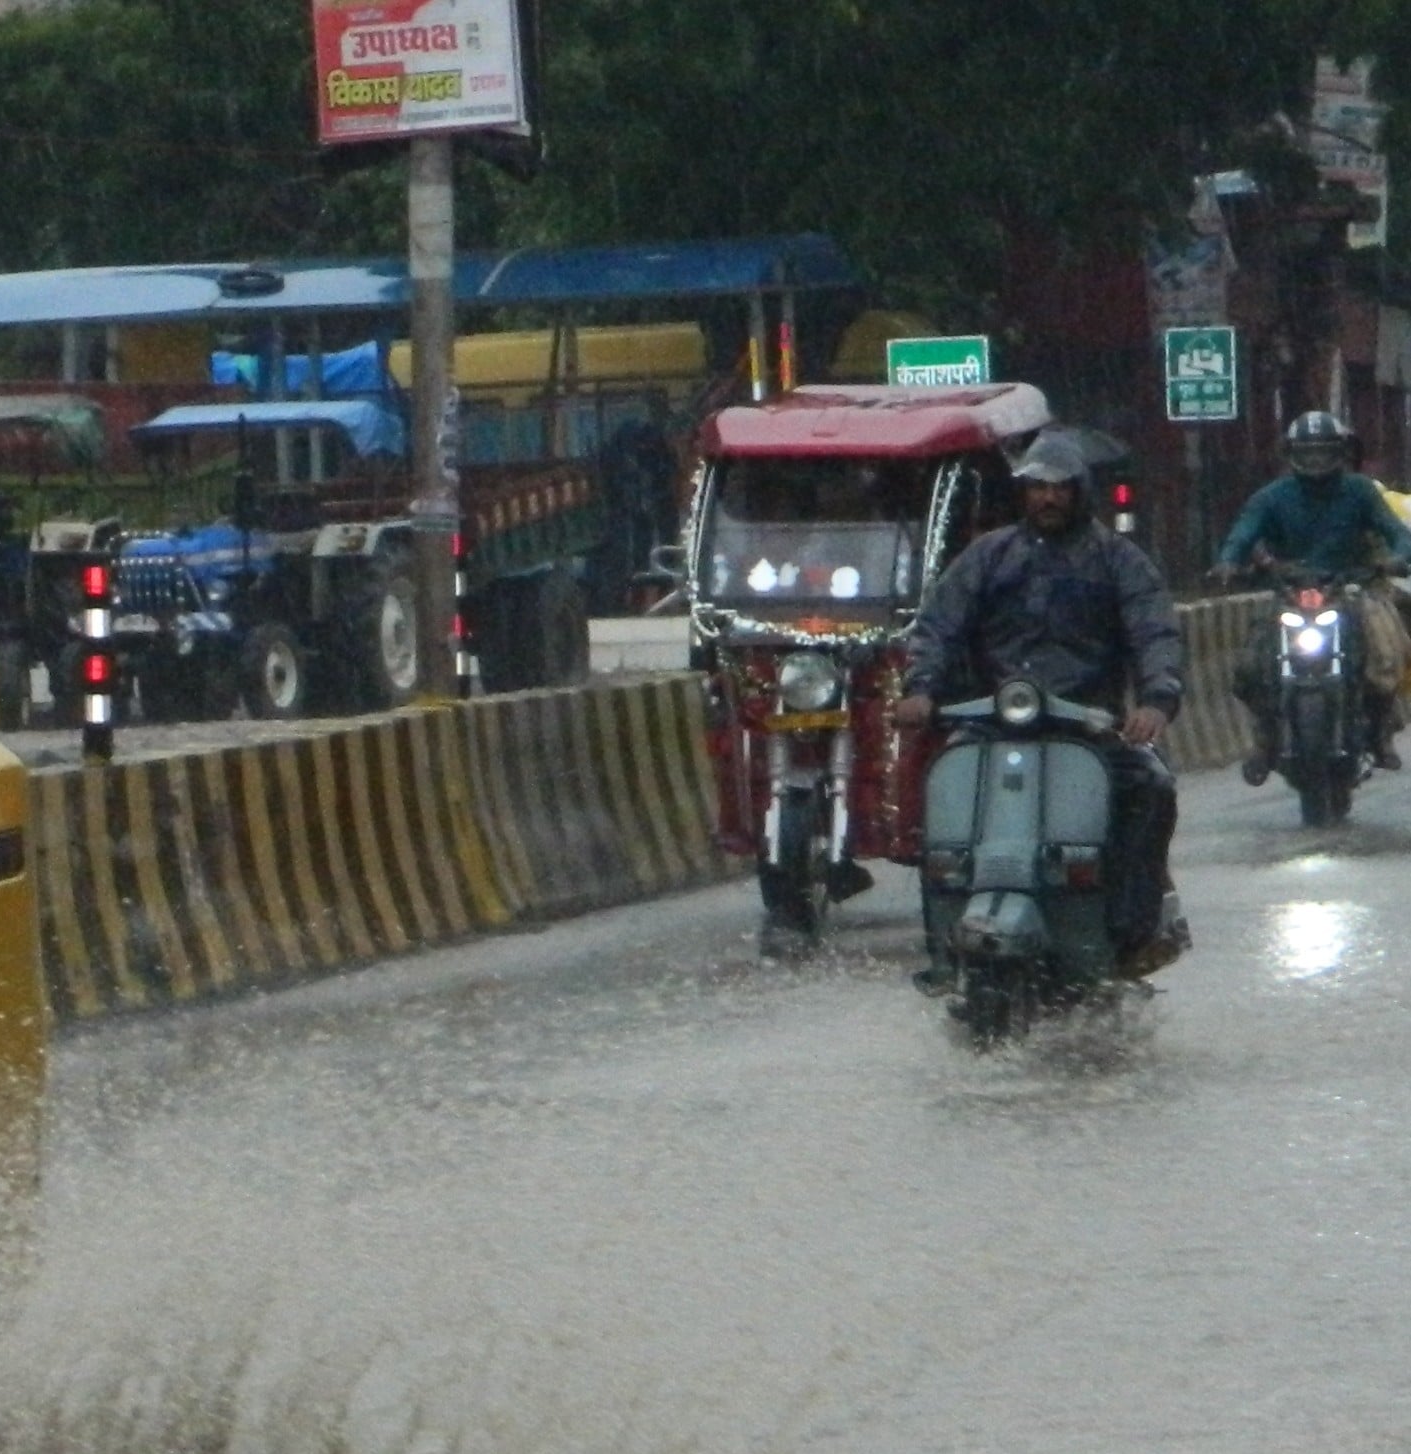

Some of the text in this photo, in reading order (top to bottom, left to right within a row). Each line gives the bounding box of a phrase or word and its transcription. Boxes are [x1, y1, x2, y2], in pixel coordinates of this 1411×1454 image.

[349, 24, 458, 58] उपाध्यक्ष
[328, 69, 400, 108] विकास
[403, 70, 462, 102] यादव
